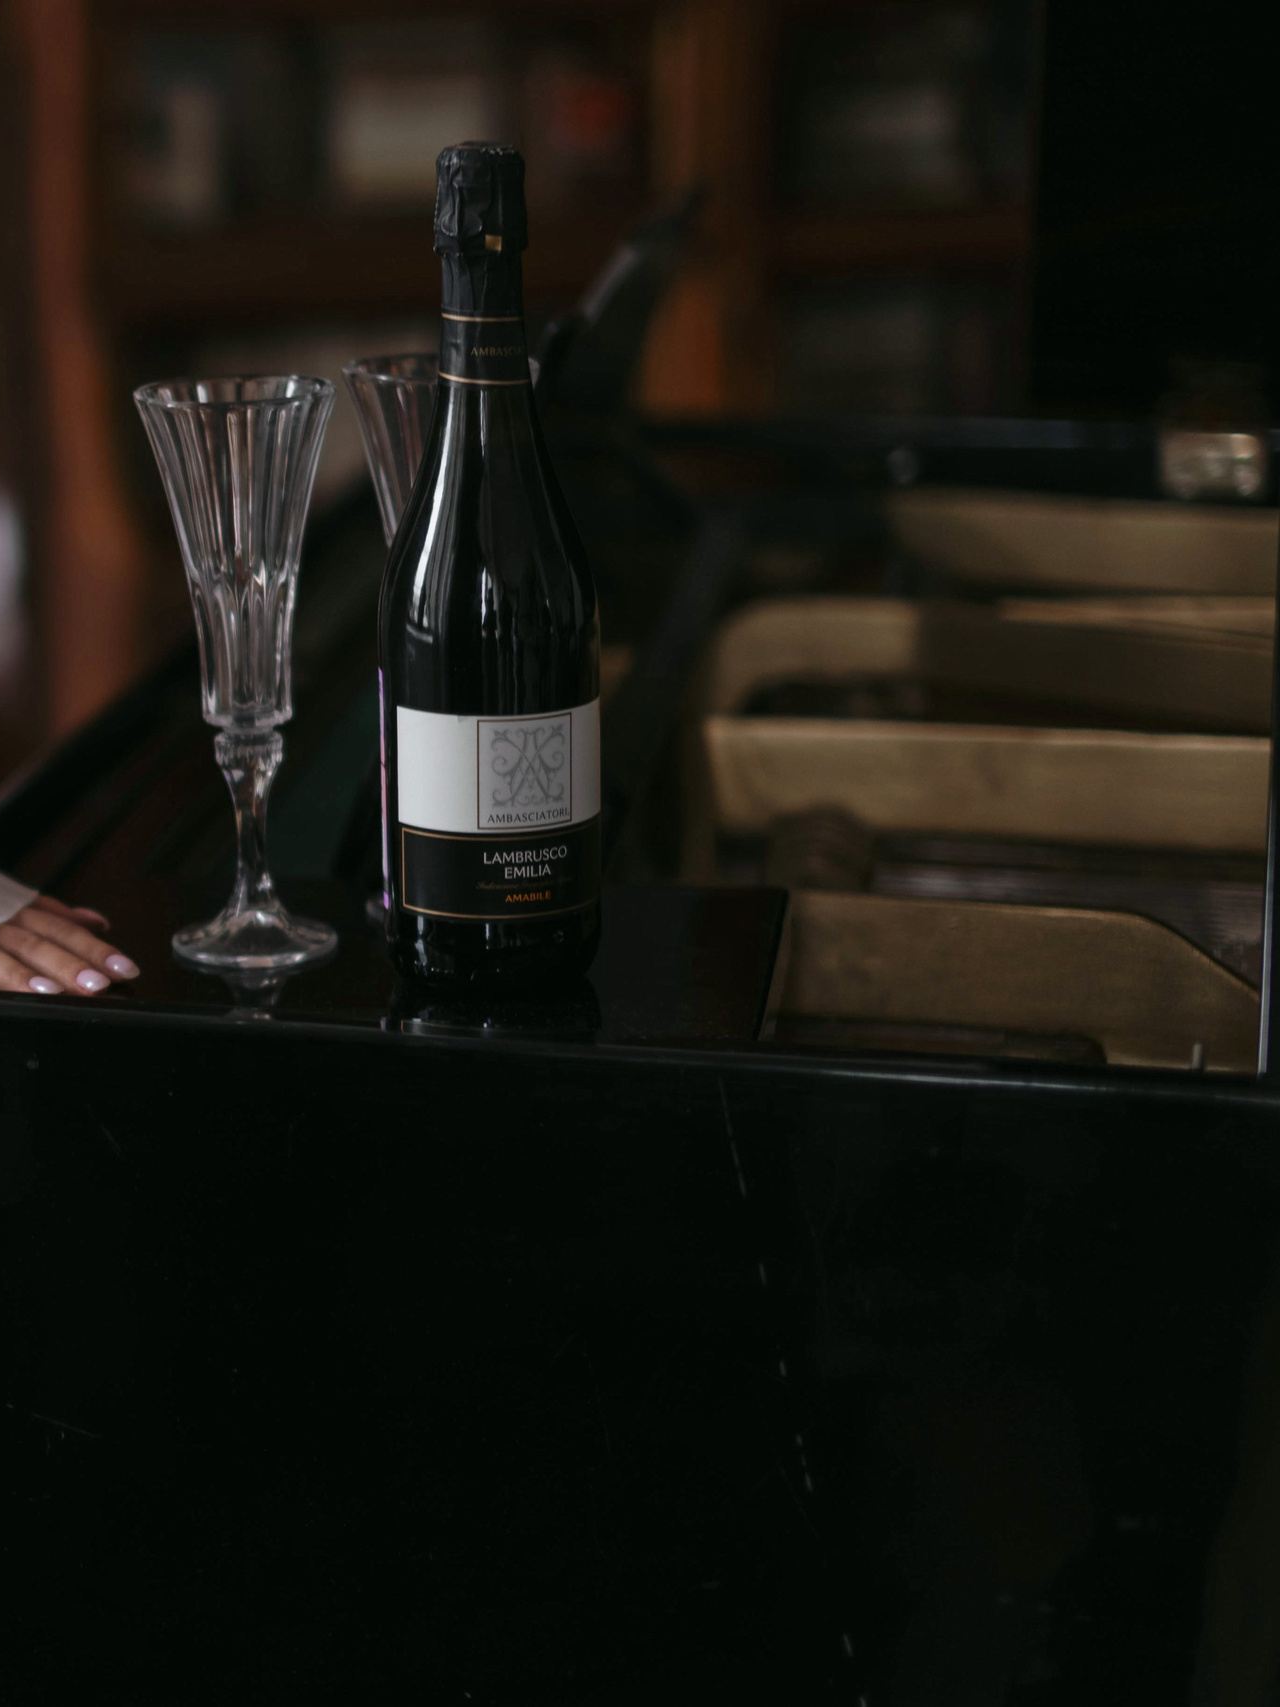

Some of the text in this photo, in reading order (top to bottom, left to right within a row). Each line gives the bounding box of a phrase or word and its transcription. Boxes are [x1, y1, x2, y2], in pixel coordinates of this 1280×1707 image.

[483, 845, 568, 865] LAMBRUSCO
[504, 863, 552, 880] EMILIA
[504, 890, 552, 904] AMABILE
